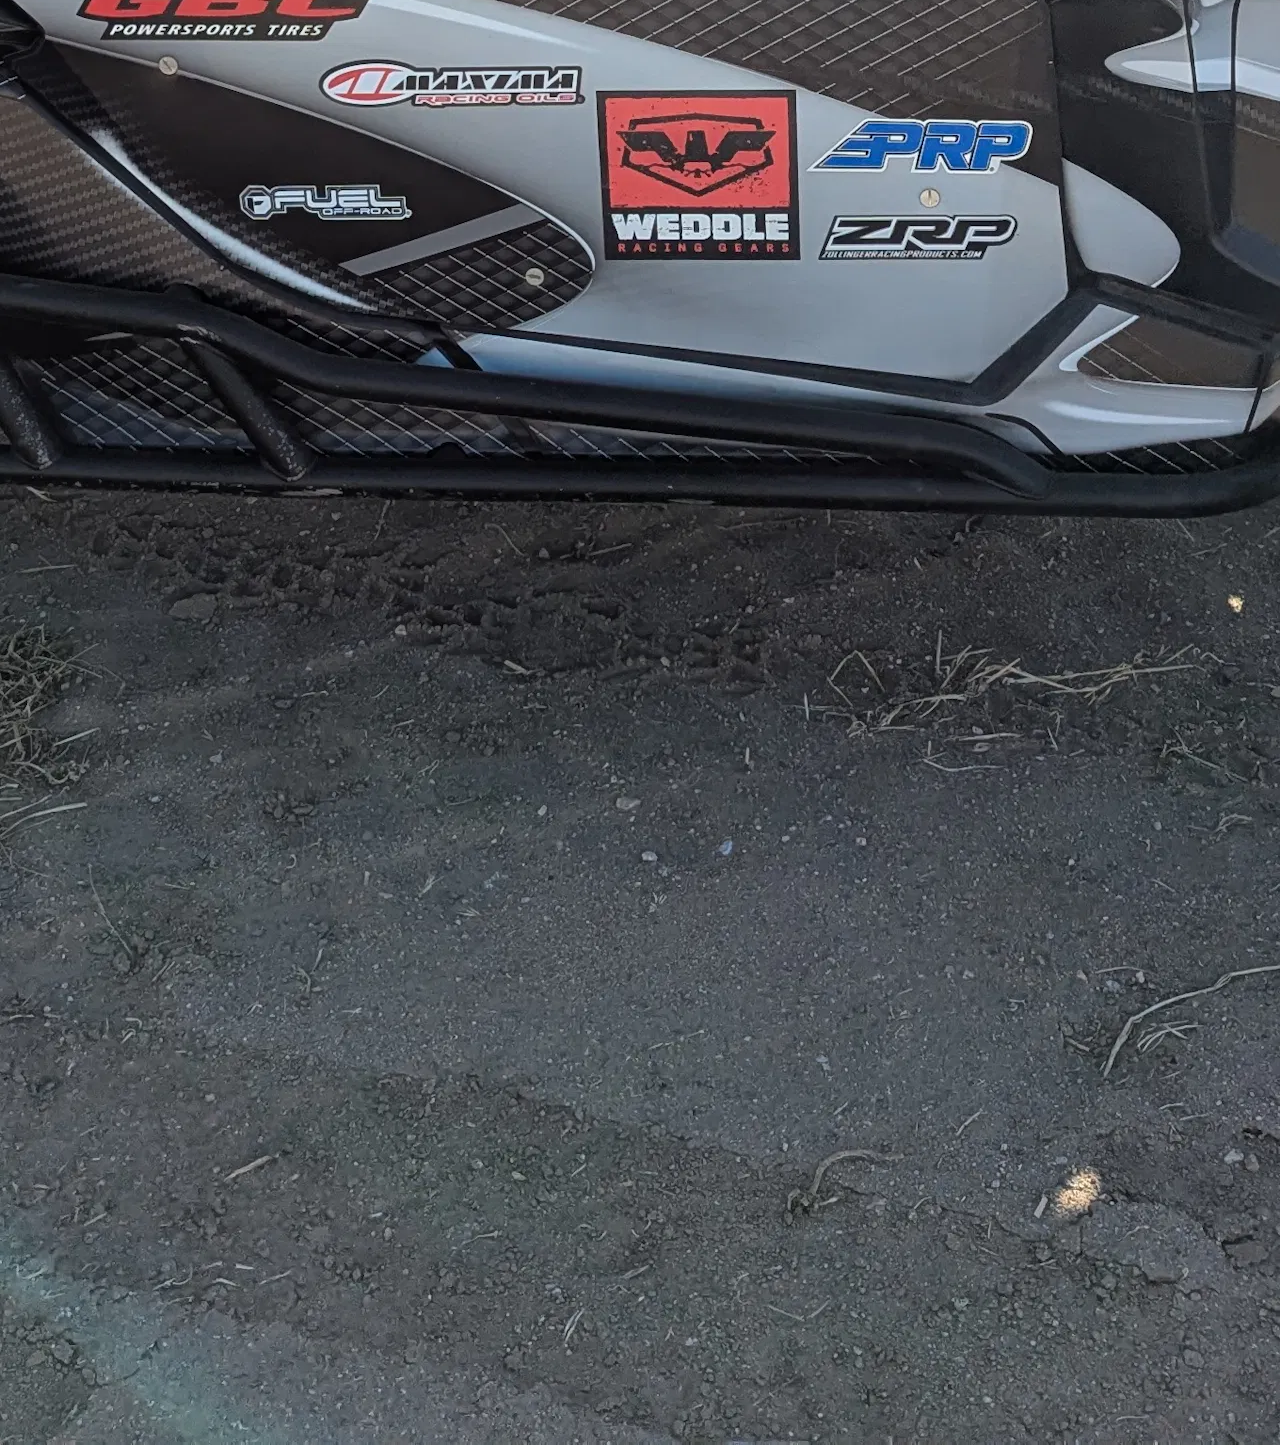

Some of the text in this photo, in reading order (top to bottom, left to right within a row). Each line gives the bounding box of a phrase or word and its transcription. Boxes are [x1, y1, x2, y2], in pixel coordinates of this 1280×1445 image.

[109, 23, 325, 37] POWERSPORTS TIRES
[415, 93, 510, 105] RACING
[810, 120, 1032, 173] PRP
[273, 188, 402, 210] FUEL
[322, 207, 404, 216] OFF-ROAD
[610, 213, 791, 241] WEDDLE
[824, 217, 1016, 250] ZRP
[618, 242, 791, 253] RACING GEARS
